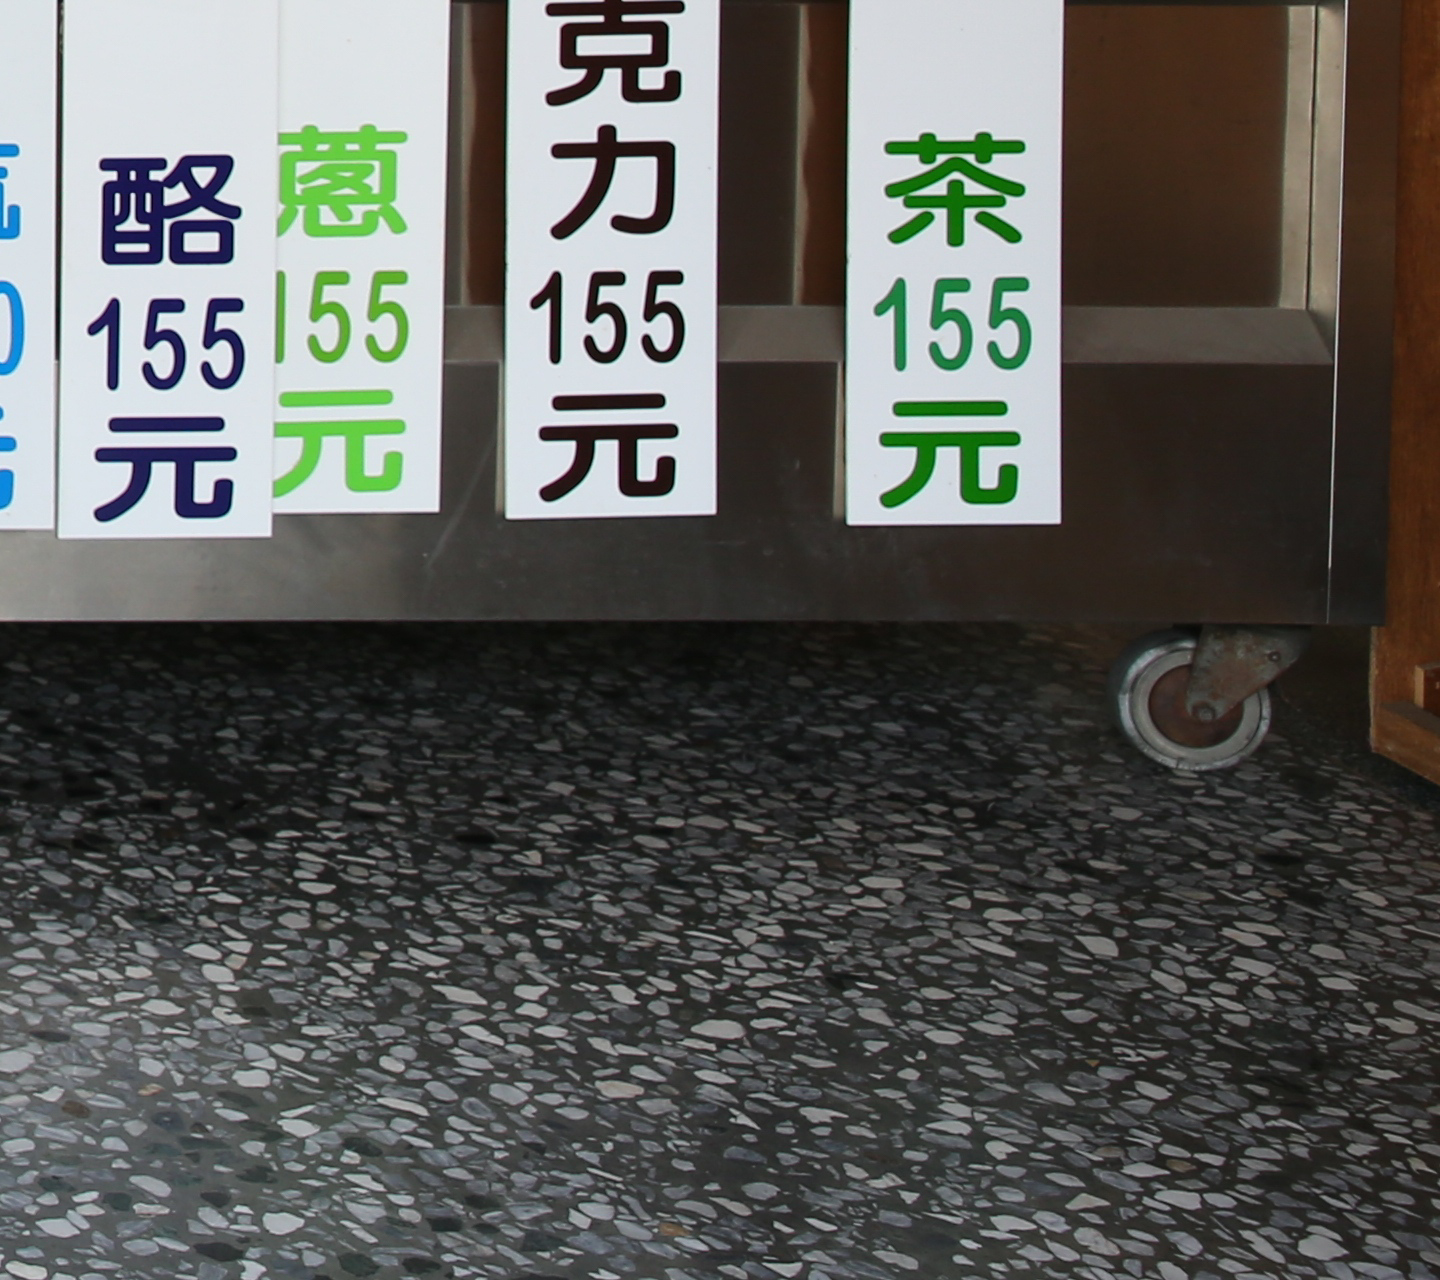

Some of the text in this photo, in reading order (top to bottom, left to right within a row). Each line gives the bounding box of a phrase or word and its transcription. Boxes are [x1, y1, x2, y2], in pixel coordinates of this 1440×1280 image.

[87, 297, 245, 392] 155
[529, 270, 686, 366] 155
[873, 277, 1033, 371] 155
[94, 416, 238, 523] 元
[272, 388, 407, 494] 元
[539, 392, 680, 503] 元
[879, 400, 1022, 509] 元
